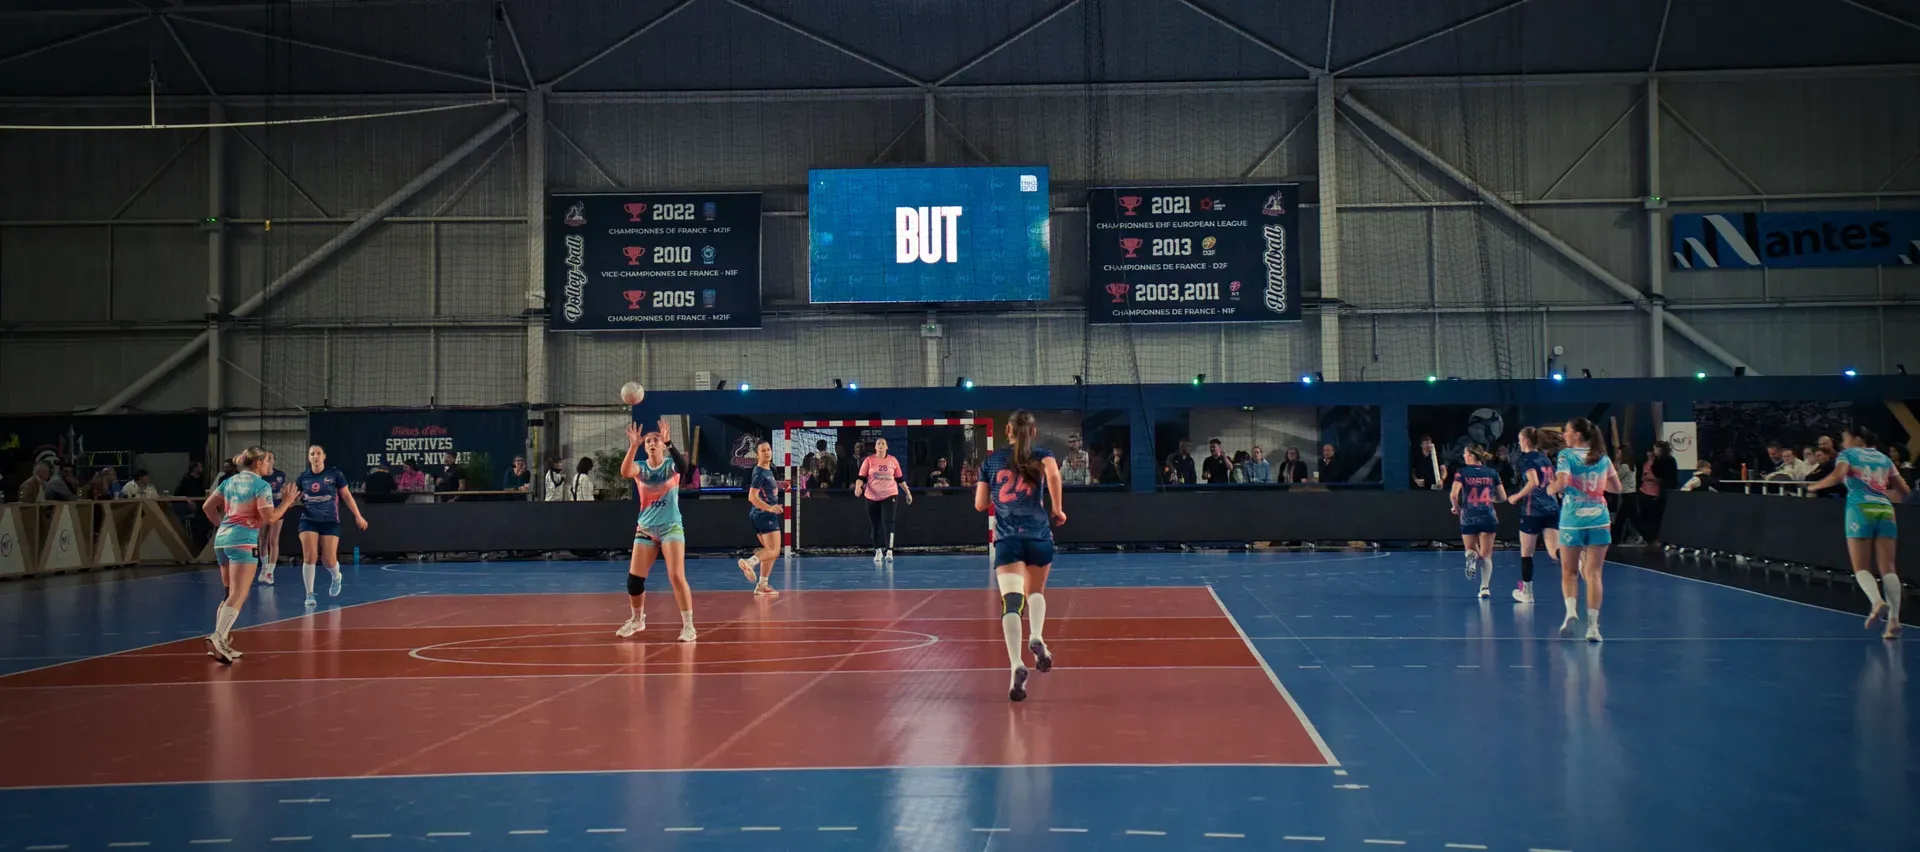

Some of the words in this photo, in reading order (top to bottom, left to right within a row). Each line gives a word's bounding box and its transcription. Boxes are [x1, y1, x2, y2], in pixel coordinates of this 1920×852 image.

[652, 203, 695, 221] 2022
[1151, 196, 1191, 214] 2021
[608, 227, 665, 235] CHAMPIONNES
[713, 226, 731, 234] M21F
[1096, 221, 1155, 229] CHAMPIONNES
[1172, 220, 1216, 228] EUROPEAN
[1216, 219, 1248, 227] LEAGUE
[895, 206, 962, 264] BUT
[653, 246, 692, 264] 2010
[1152, 238, 1192, 256] 2013
[600, 270, 676, 278] VICE-CHAMPIONNES
[689, 269, 720, 277] FRANCE
[1103, 263, 1162, 271] CHAMPIONNES
[1175, 262, 1207, 270] FRANCE
[1263, 224, 1286, 313] Handball
[564, 234, 588, 322] Volley-ball
[652, 290, 695, 308] 2005
[1135, 282, 1220, 303] 2003,2011
[607, 314, 664, 322] CHAMPIONNES
[1112, 308, 1171, 316] CHAMPIONNES
[1184, 307, 1217, 315] FRANCE
[385, 437, 453, 451] SPORTIVES
[366, 453, 381, 466] DE
[386, 451, 471, 466] HAUT-NIVAU
[878, 464, 888, 472] 28
[311, 482, 320, 493] 9
[996, 469, 1032, 503] 24
[1580, 471, 1599, 492] 19
[1467, 487, 1491, 507] 44
